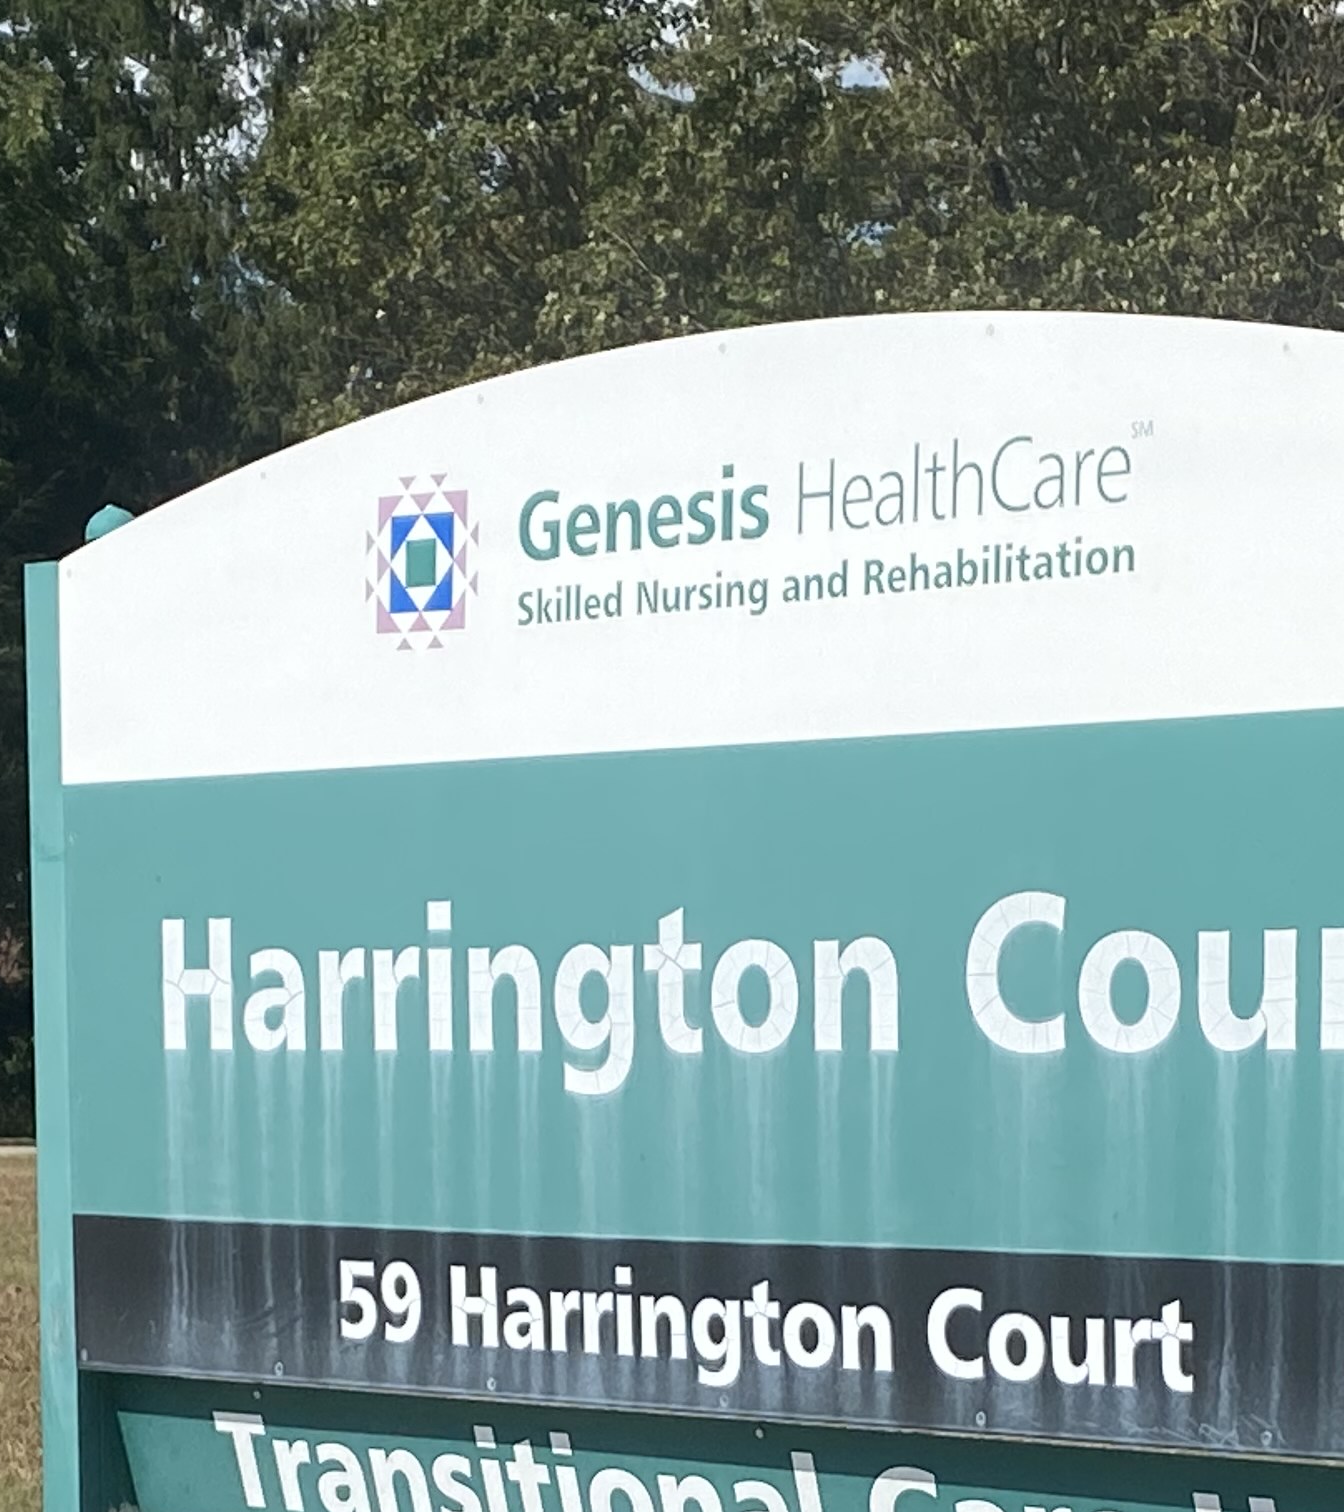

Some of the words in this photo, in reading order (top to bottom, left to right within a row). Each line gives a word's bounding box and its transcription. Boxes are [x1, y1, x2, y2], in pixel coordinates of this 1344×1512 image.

[519, 465, 770, 560] Genesis
[797, 436, 1131, 533] HealthCare
[1130, 420, 1156, 440] SM
[517, 583, 623, 627] Skilled
[636, 570, 770, 616] Nursing
[782, 560, 849, 602] and
[864, 537, 1136, 596] Rehabilitation
[162, 901, 899, 1096] Harrington
[338, 1260, 424, 1347] 59
[449, 1264, 895, 1390] Harrington
[926, 1287, 1197, 1395] Court
